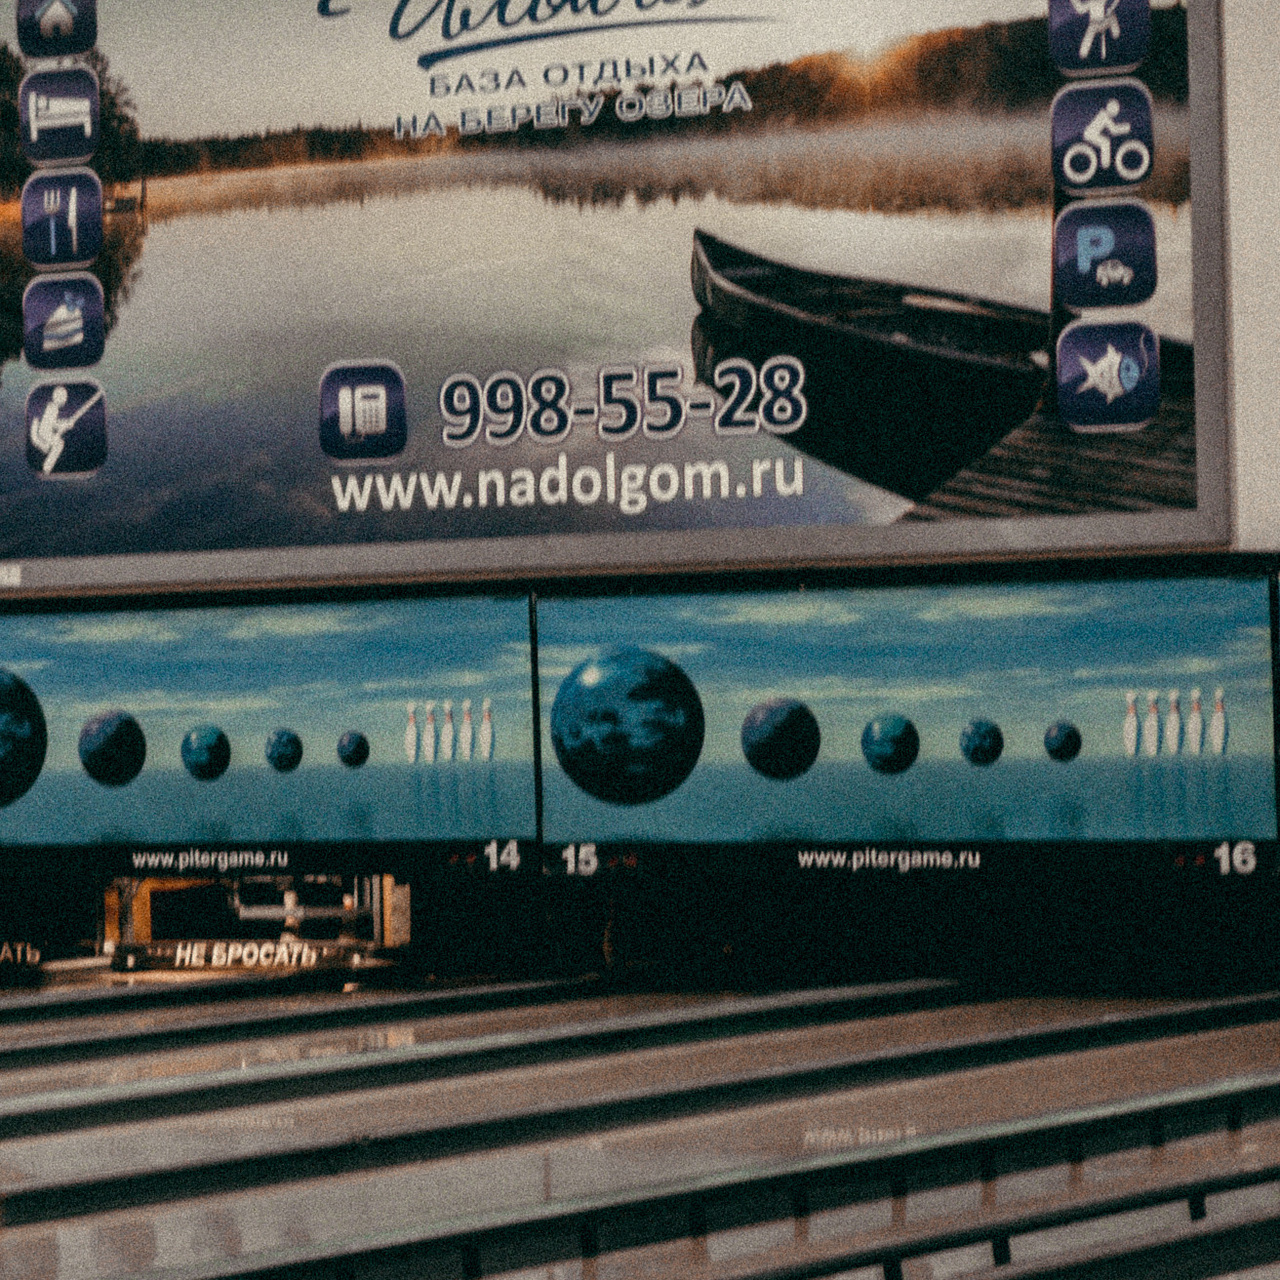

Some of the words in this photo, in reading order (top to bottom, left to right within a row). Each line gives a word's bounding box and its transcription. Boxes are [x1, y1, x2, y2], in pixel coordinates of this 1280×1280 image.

[429, 69, 526, 98] БАЗА
[543, 51, 708, 87] ОТДЫХА
[395, 110, 447, 140] НА
[459, 94, 605, 135] БЕРЕГУ
[615, 80, 753, 121] ОЗЕРА
[440, 355, 808, 447] 998-55-28
[331, 452, 804, 515] www.nadolgom.ru
[132, 847, 289, 873] www.pitergame.ru
[484, 839, 520, 871] 14
[561, 842, 598, 876] 15
[797, 846, 981, 874] www.pitergame.ru
[1214, 840, 1257, 875] 16
[174, 941, 207, 968] НЕ
[211, 941, 318, 968] БРОСАТЬ
